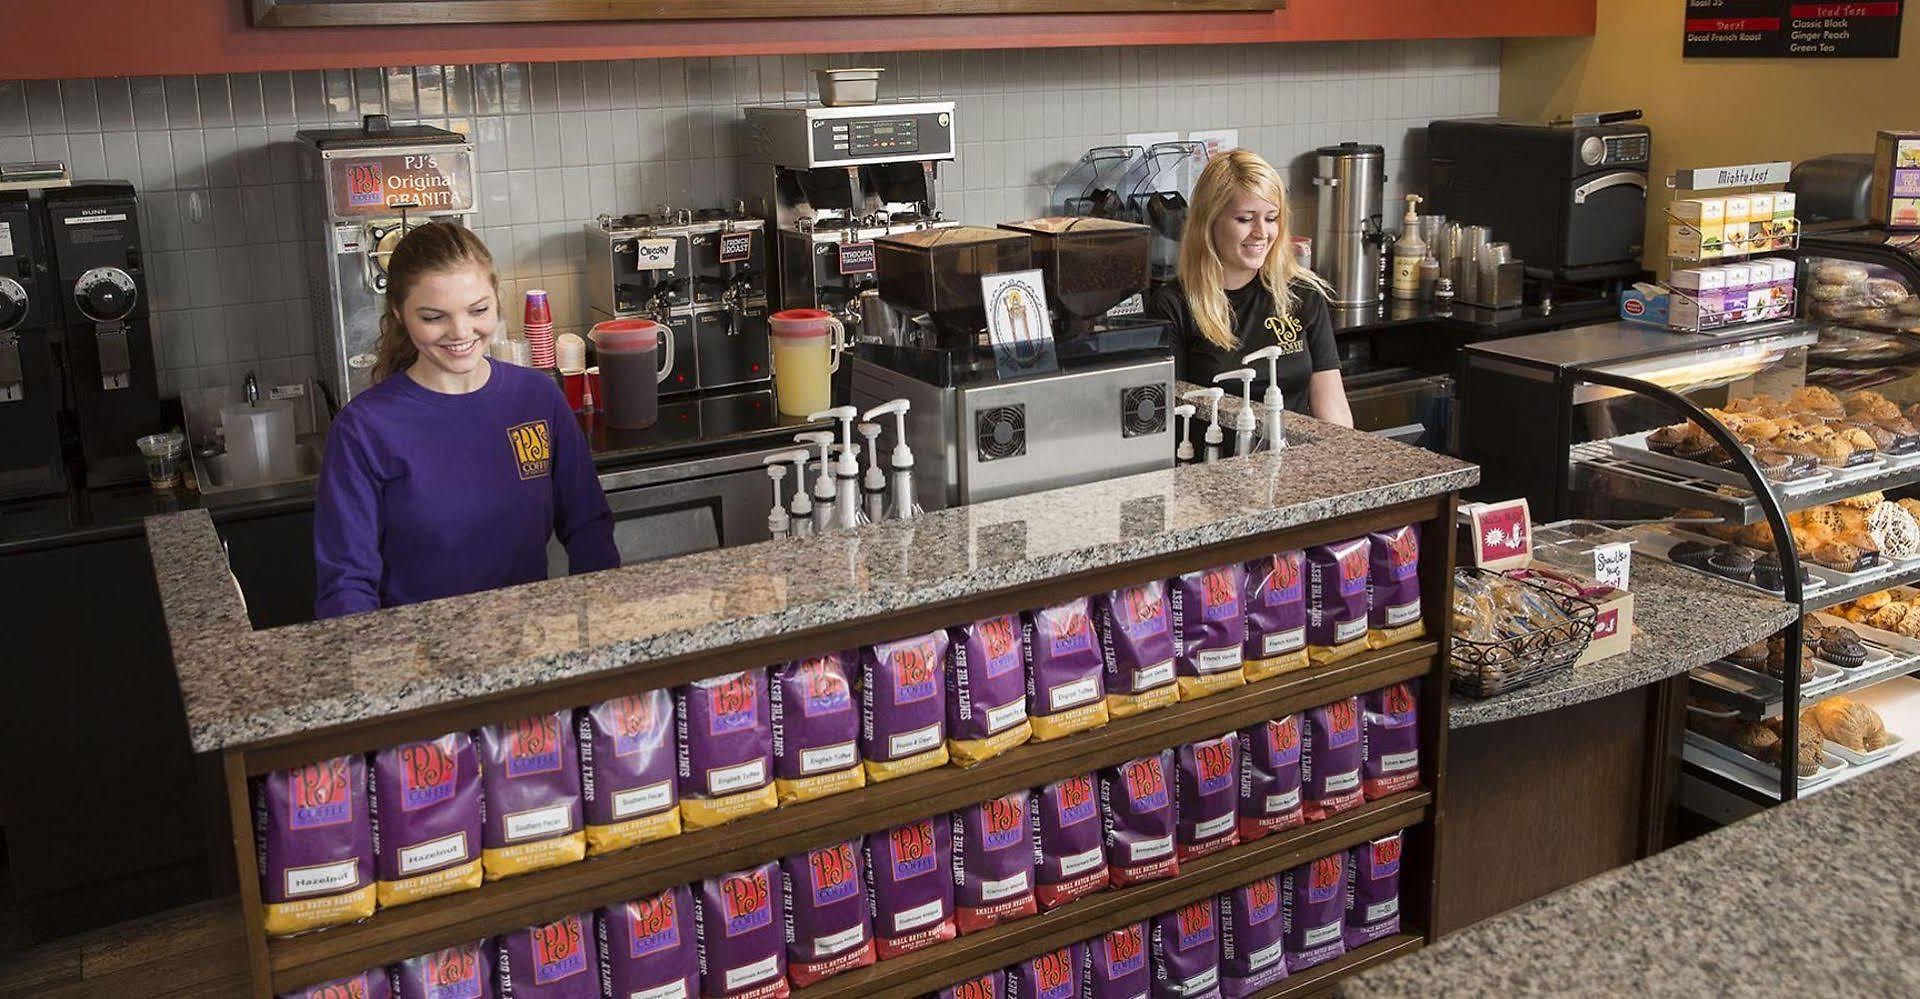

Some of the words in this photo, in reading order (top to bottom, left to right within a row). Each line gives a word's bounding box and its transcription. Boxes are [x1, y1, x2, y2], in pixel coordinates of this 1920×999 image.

[1792, 20, 1821, 28] Classic
[1824, 19, 1848, 28] Black
[1791, 31, 1821, 41] Ginger
[1824, 30, 1850, 39] Peach
[1790, 43, 1817, 52] Green
[1819, 43, 1835, 52] Tea
[404, 154, 438, 169] PJ's
[387, 173, 456, 191] Original
[1717, 169, 1749, 185] Mighty
[1750, 168, 1768, 183] Leaf
[386, 191, 460, 207] GRANITA
[1264, 316, 1302, 344] PJ's
[511, 424, 549, 462] PJ's
[1311, 562, 1322, 583] BEST
[1172, 589, 1183, 610] BEST
[1311, 584, 1322, 599] THE
[1173, 612, 1183, 627] THE
[1103, 629, 1113, 645] THE
[955, 643, 968, 667] BEST
[1104, 646, 1118, 674] SIMPLY
[896, 648, 936, 687] PJ's
[956, 668, 970, 687] THE
[770, 679, 782, 702] BEST
[863, 690, 873, 707] THE
[771, 703, 783, 721] THE
[958, 688, 972, 720] SIMPLY
[678, 721, 688, 740] THE
[863, 708, 873, 740] SIMPLY
[772, 723, 784, 757] SIMPLY
[581, 742, 592, 762] THE
[679, 743, 690, 778] SIMPLY
[1197, 742, 1233, 780] PJ's
[402, 744, 456, 789] PJ's
[1302, 754, 1312, 782] SIMPLY
[583, 764, 594, 801] SIMPLY
[1128, 760, 1161, 800] PJ's
[1240, 768, 1252, 799] SIMPLY
[984, 800, 1021, 834] PJ's
[409, 845, 458, 864] Hazelnut
[894, 824, 933, 864] PJ's
[953, 836, 964, 853] THE
[812, 845, 855, 890] PJ's
[953, 856, 964, 886] SIMPLY
[296, 873, 348, 887] Hazelnut
[725, 875, 767, 918] PJ's
[784, 894, 793, 911] THE
[976, 905, 995, 915] SMALL
[697, 923, 705, 940] THE
[785, 914, 795, 943] SIMPLY
[889, 936, 909, 947] SMALL
[909, 930, 926, 941] BATCH
[535, 921, 581, 965] PJ's
[600, 940, 609, 959] THE
[698, 943, 708, 975] SIMPLY
[808, 961, 829, 973] SMALL
[830, 955, 847, 967] BATCH
[1035, 950, 1070, 991] PJ's
[501, 974, 512, 993] THE
[761, 980, 784, 993] ROASTED
[1007, 972, 1018, 994] BEST
